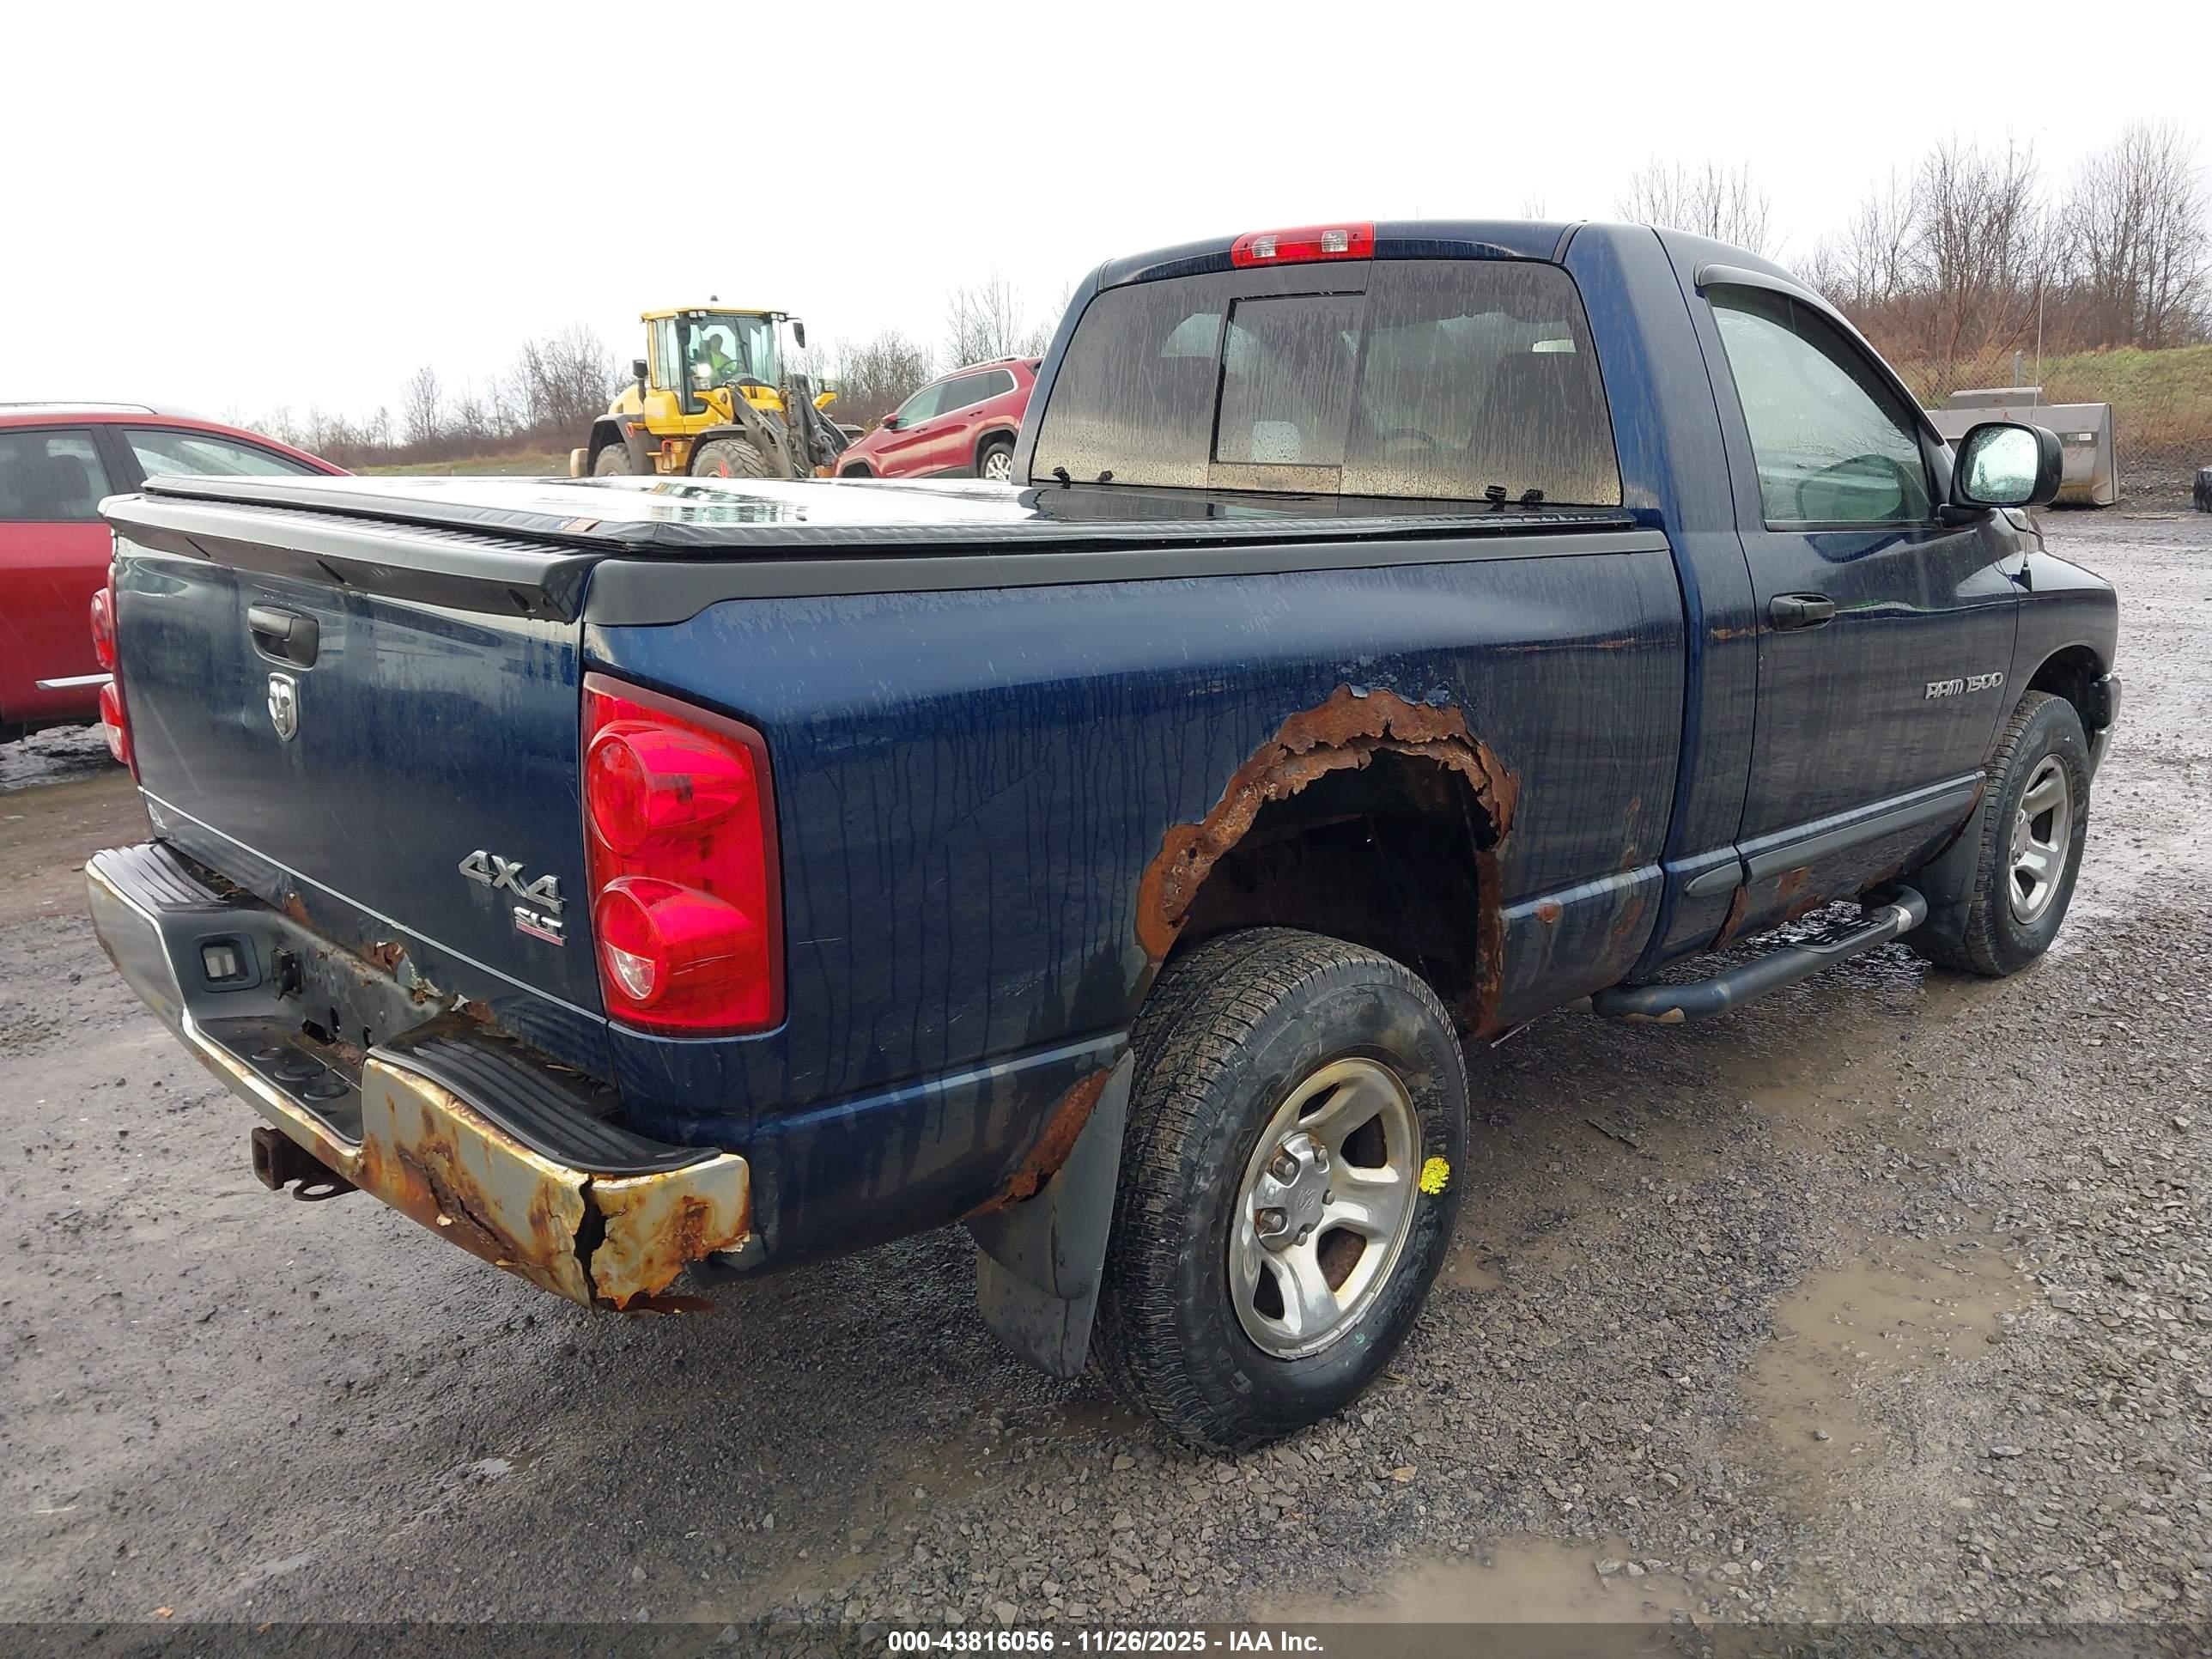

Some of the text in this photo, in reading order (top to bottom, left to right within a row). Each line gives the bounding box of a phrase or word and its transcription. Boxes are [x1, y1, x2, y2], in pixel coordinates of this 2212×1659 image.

[1924, 672, 2004, 700] RAM 1500
[514, 906, 563, 936] SLT
